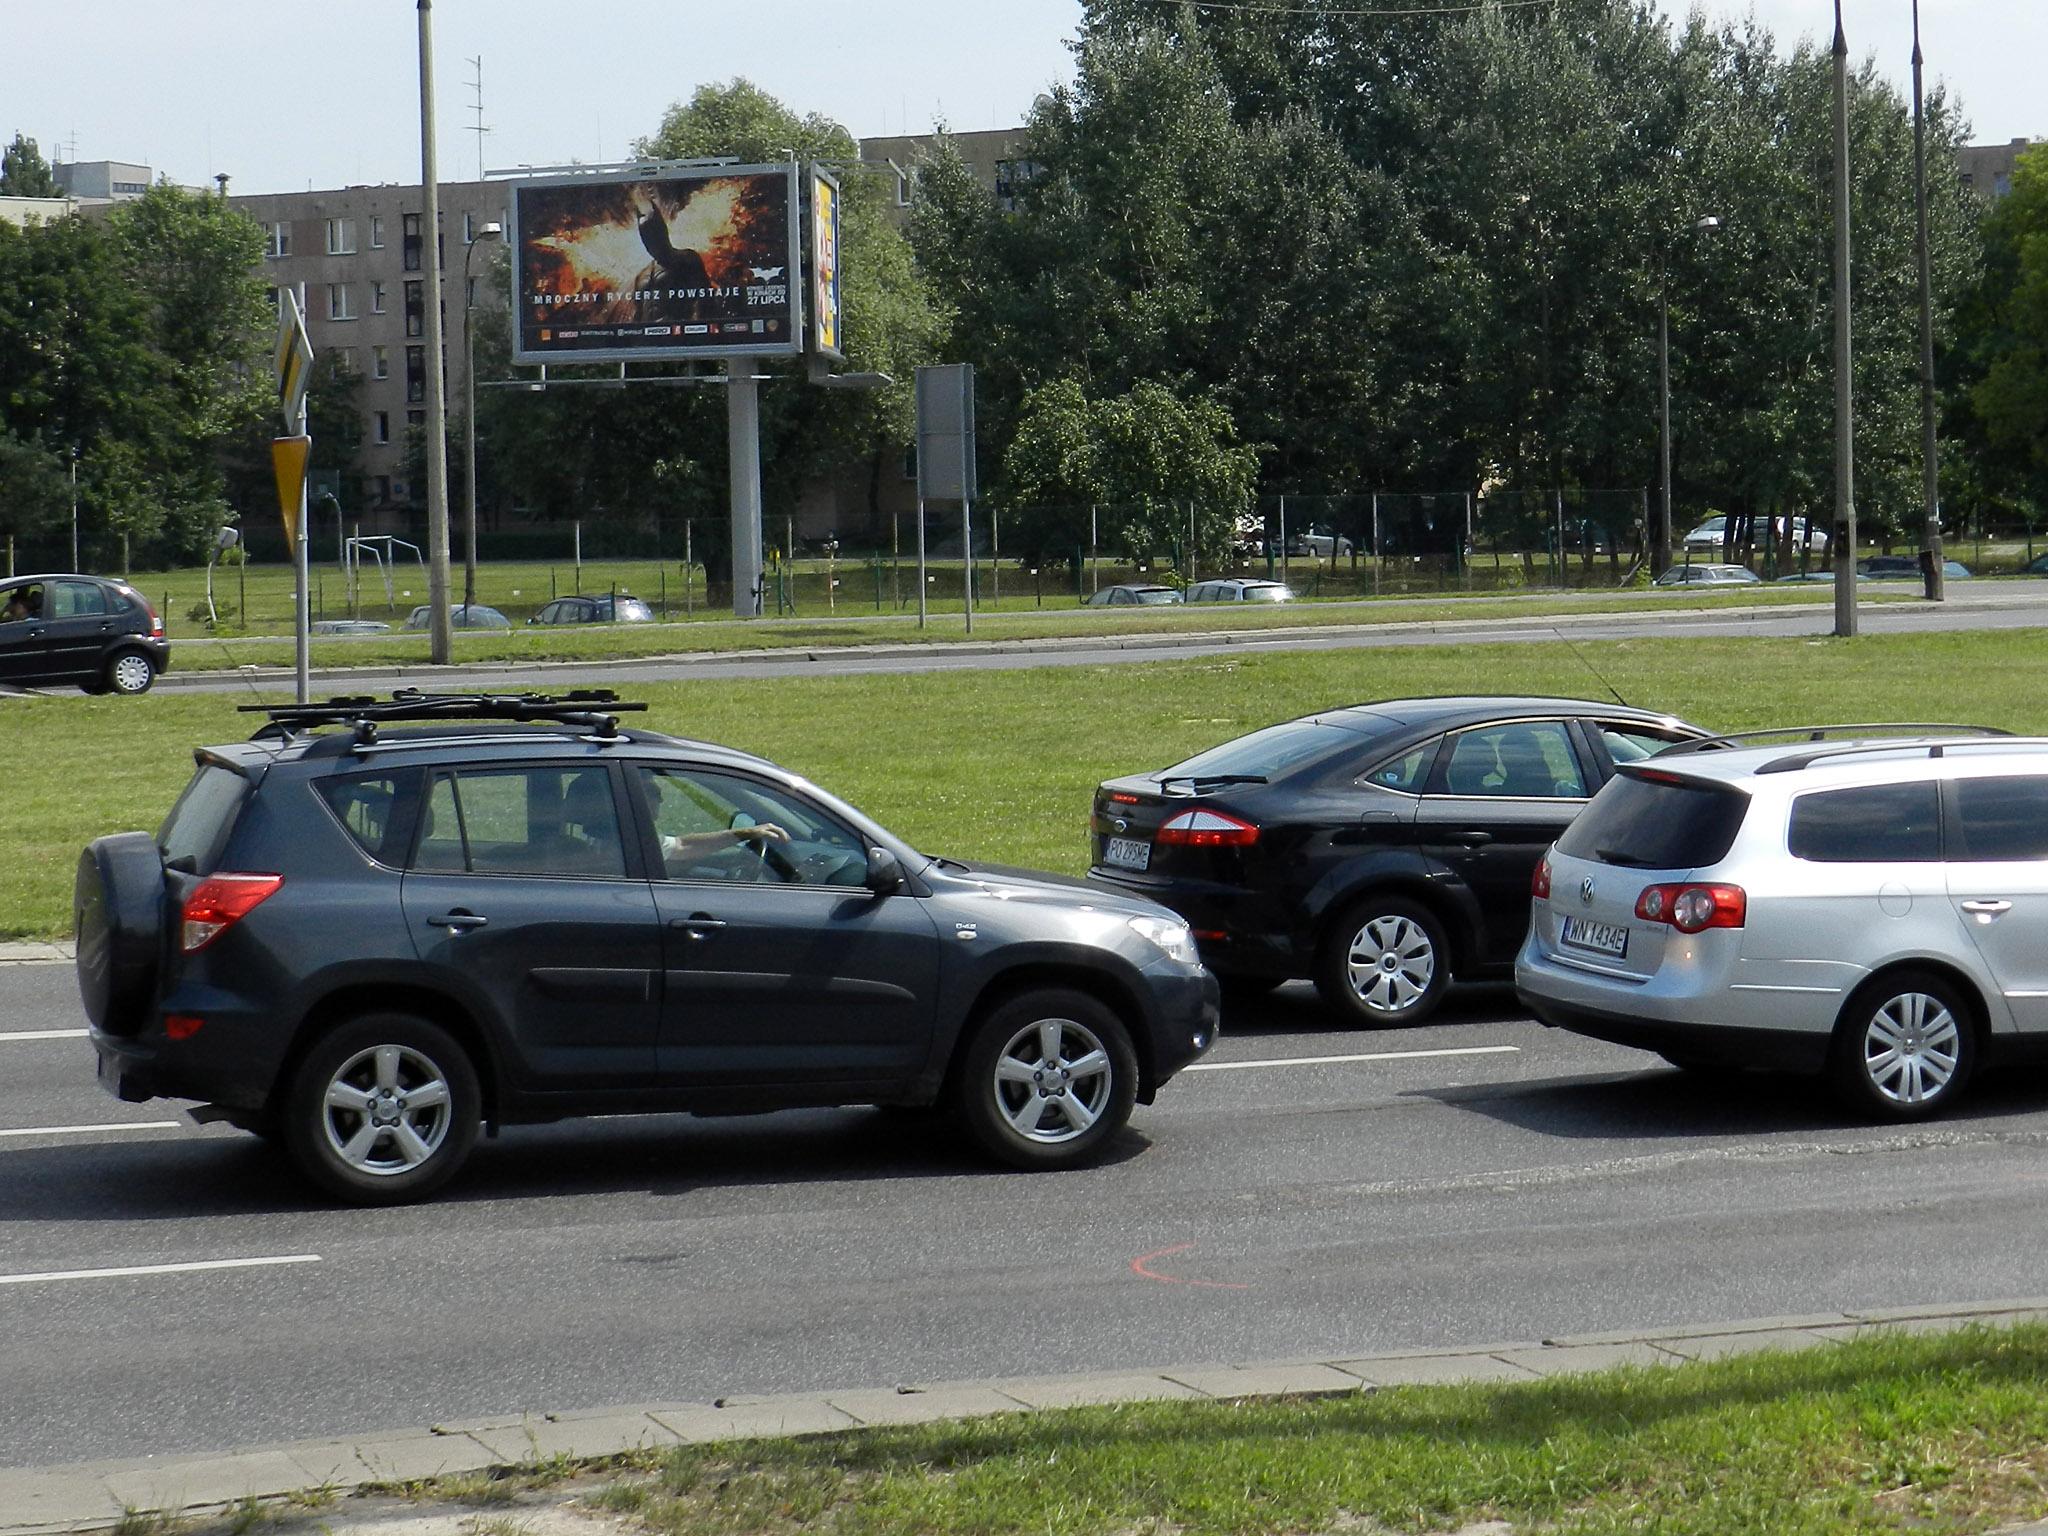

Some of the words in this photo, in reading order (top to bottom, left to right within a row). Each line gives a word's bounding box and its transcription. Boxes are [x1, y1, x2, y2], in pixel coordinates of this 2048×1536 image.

[534, 293, 599, 304] MROCZNY
[607, 291, 660, 301] RYCERZ
[668, 287, 740, 298] POWSTAJE
[760, 295, 786, 304] LIPCA
[1111, 839, 1123, 858] PO
[1570, 918, 1589, 942] WN
[1590, 923, 1626, 950] 1434E
